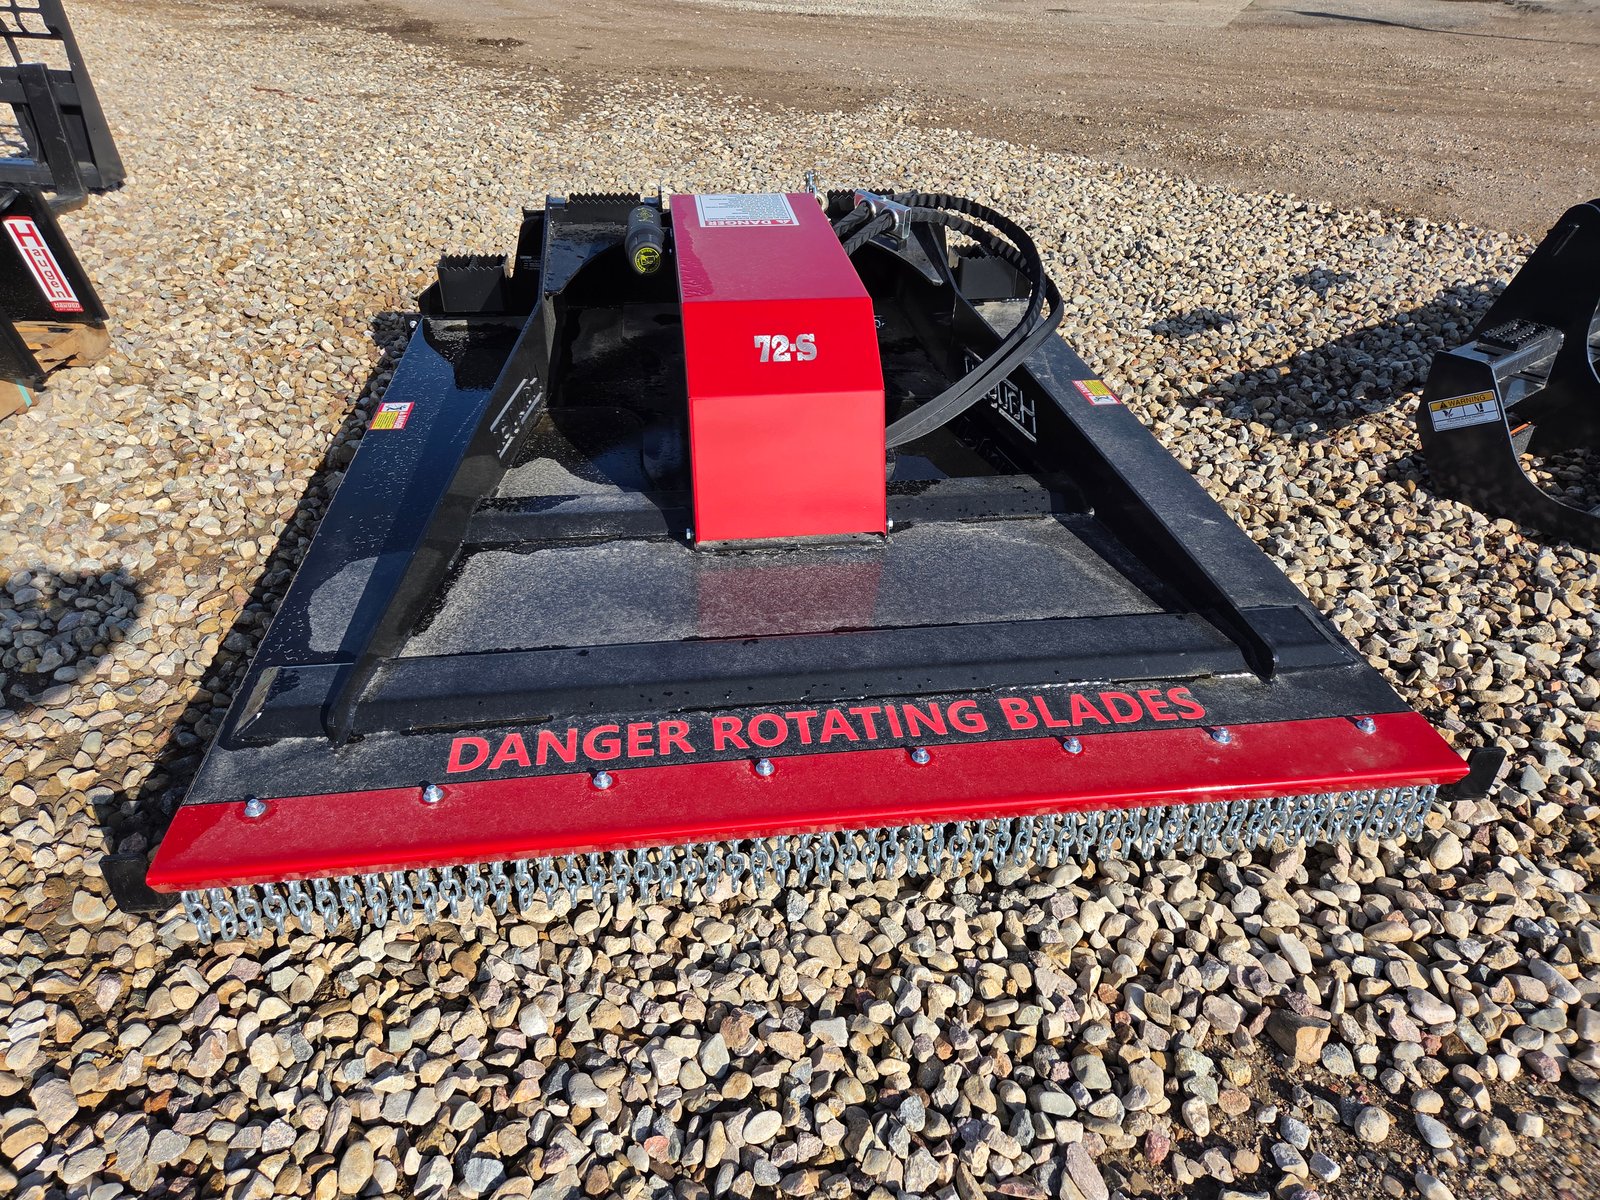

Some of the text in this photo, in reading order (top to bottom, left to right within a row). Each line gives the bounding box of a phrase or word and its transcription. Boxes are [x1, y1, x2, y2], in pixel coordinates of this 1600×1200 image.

[9, 223, 68, 298] Haugen
[1448, 395, 1486, 407] WARNING
[447, 687, 1206, 773] DANGER ROTATING BLADES
